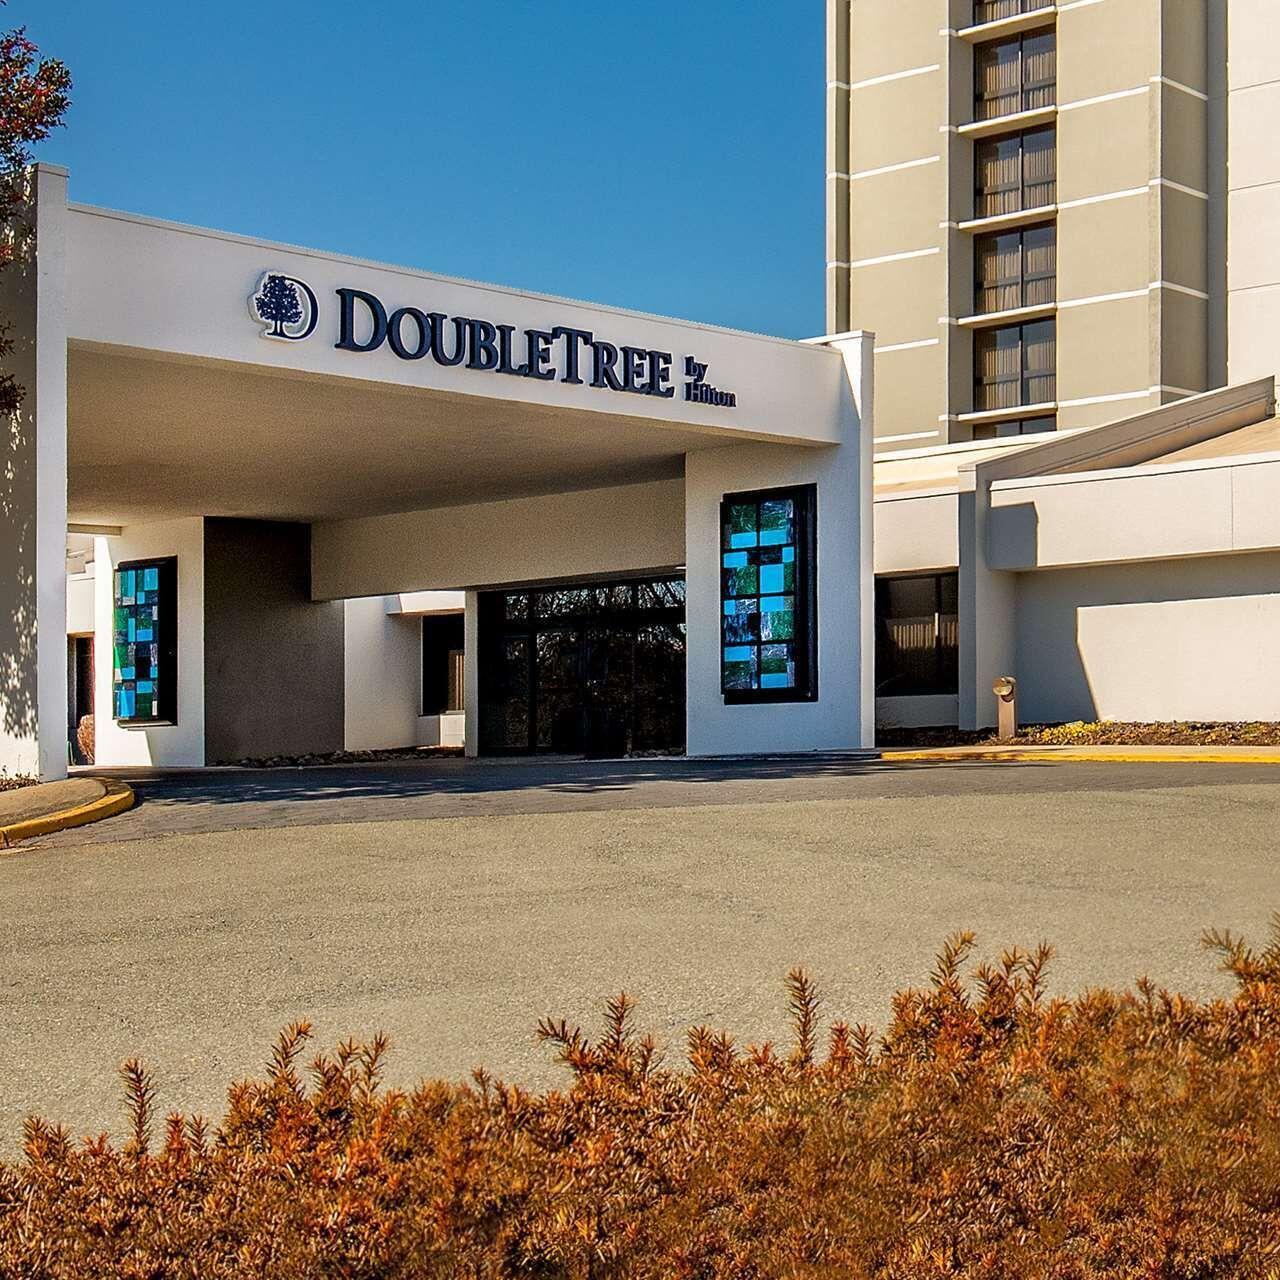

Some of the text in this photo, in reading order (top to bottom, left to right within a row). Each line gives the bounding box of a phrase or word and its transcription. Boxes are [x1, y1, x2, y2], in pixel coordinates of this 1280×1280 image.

[334, 287, 675, 399] DOUBLETREE
[684, 355, 708, 383] by
[684, 382, 737, 408] Hilton
